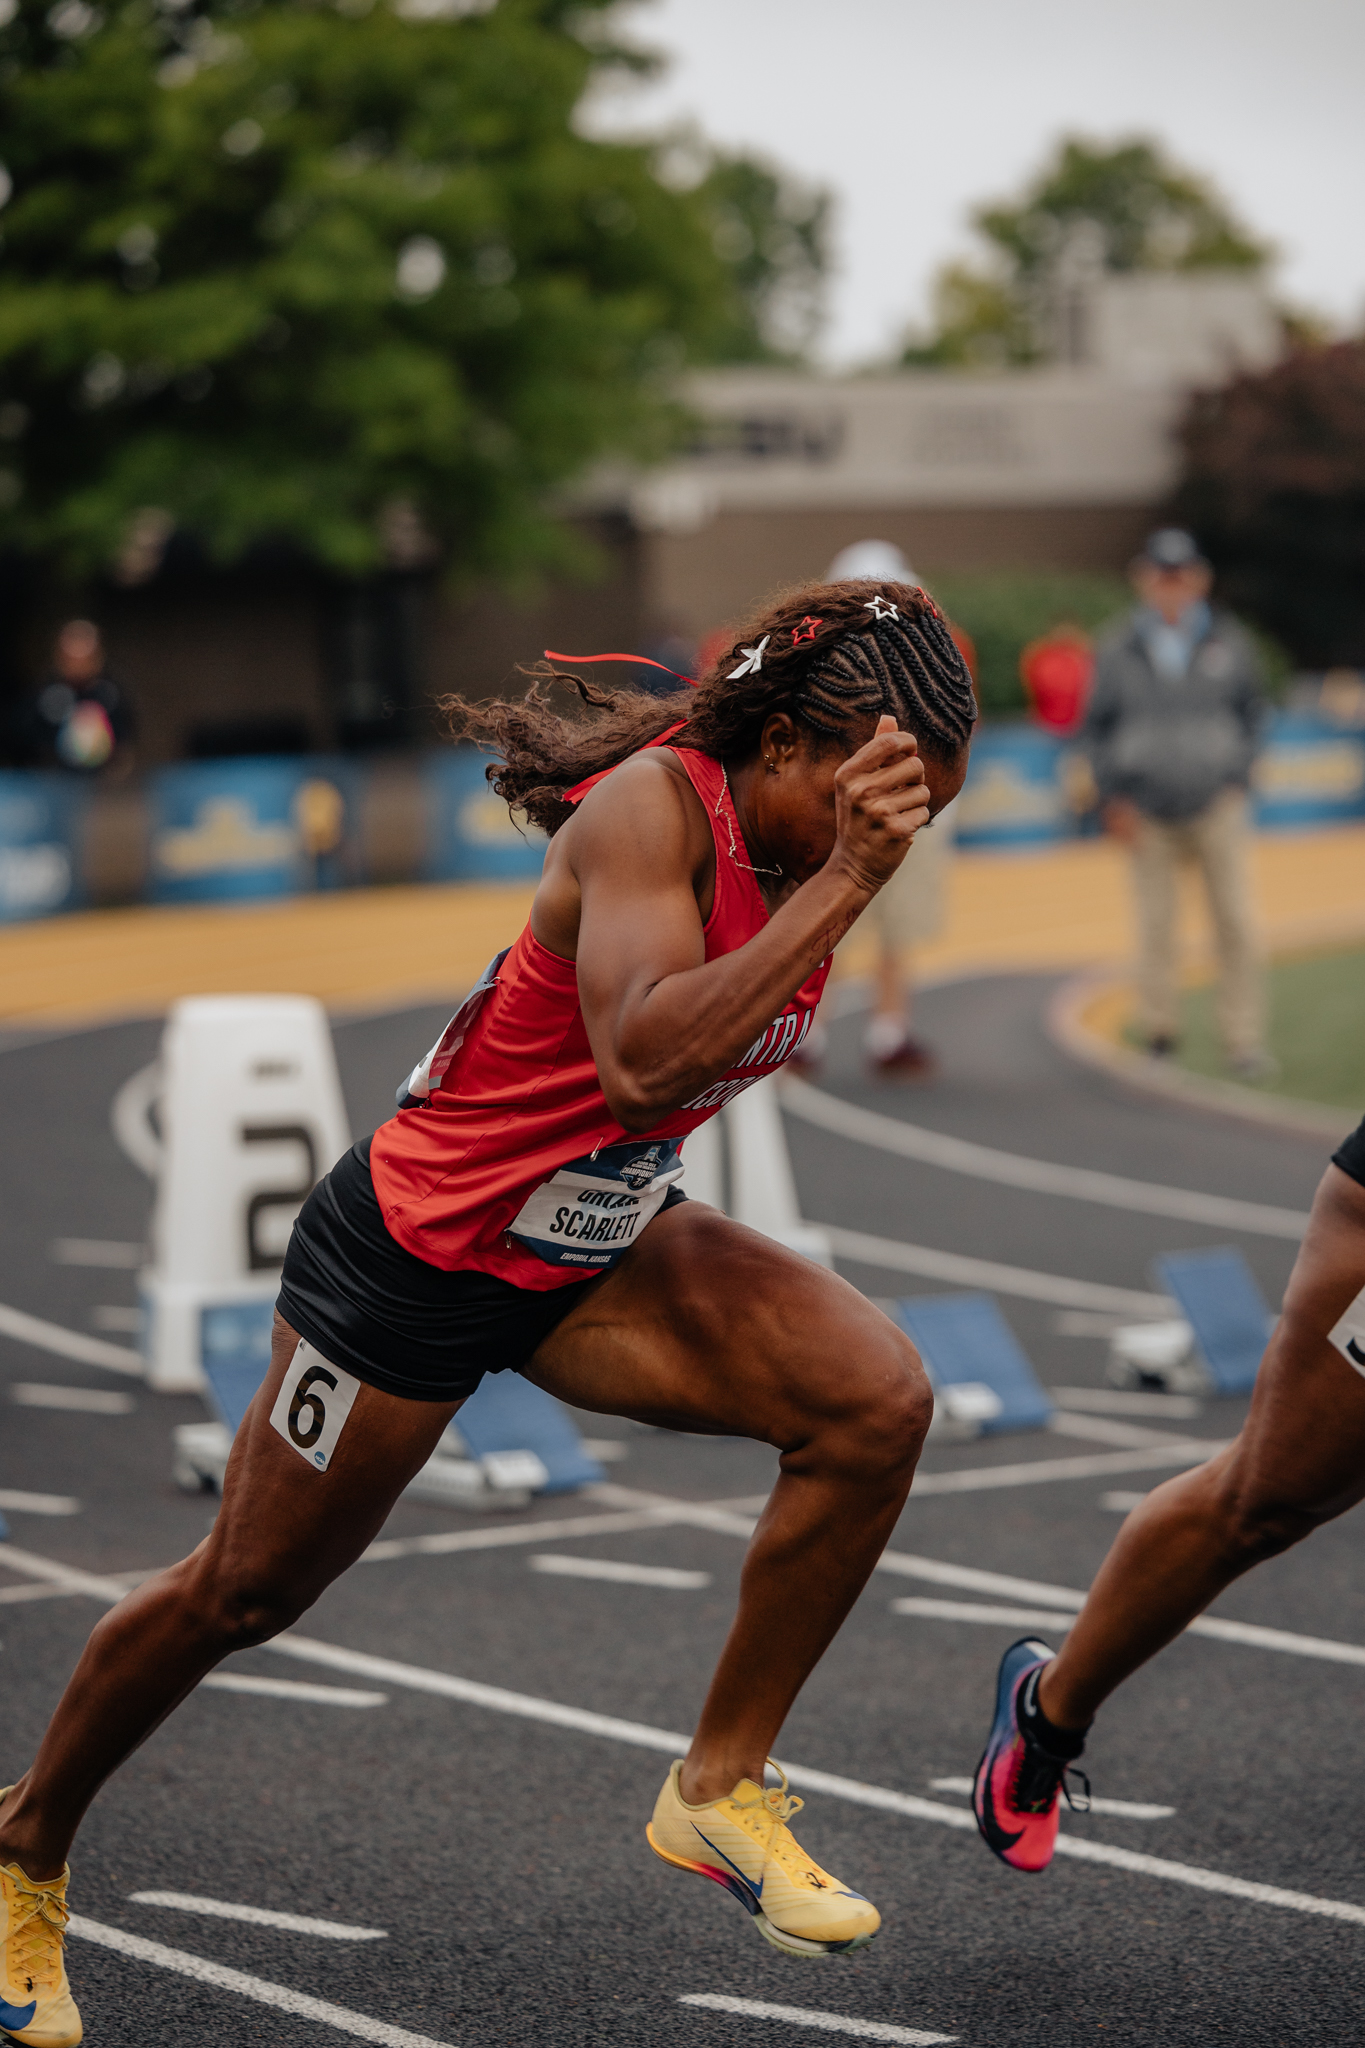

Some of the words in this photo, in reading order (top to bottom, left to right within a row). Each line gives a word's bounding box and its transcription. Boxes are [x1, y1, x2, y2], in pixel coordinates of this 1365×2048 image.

[241, 1124, 317, 1271] 2
[549, 1206, 641, 1242] SCARLETT
[588, 1255, 612, 1263] KANSAS
[287, 1365, 339, 1449] 6
